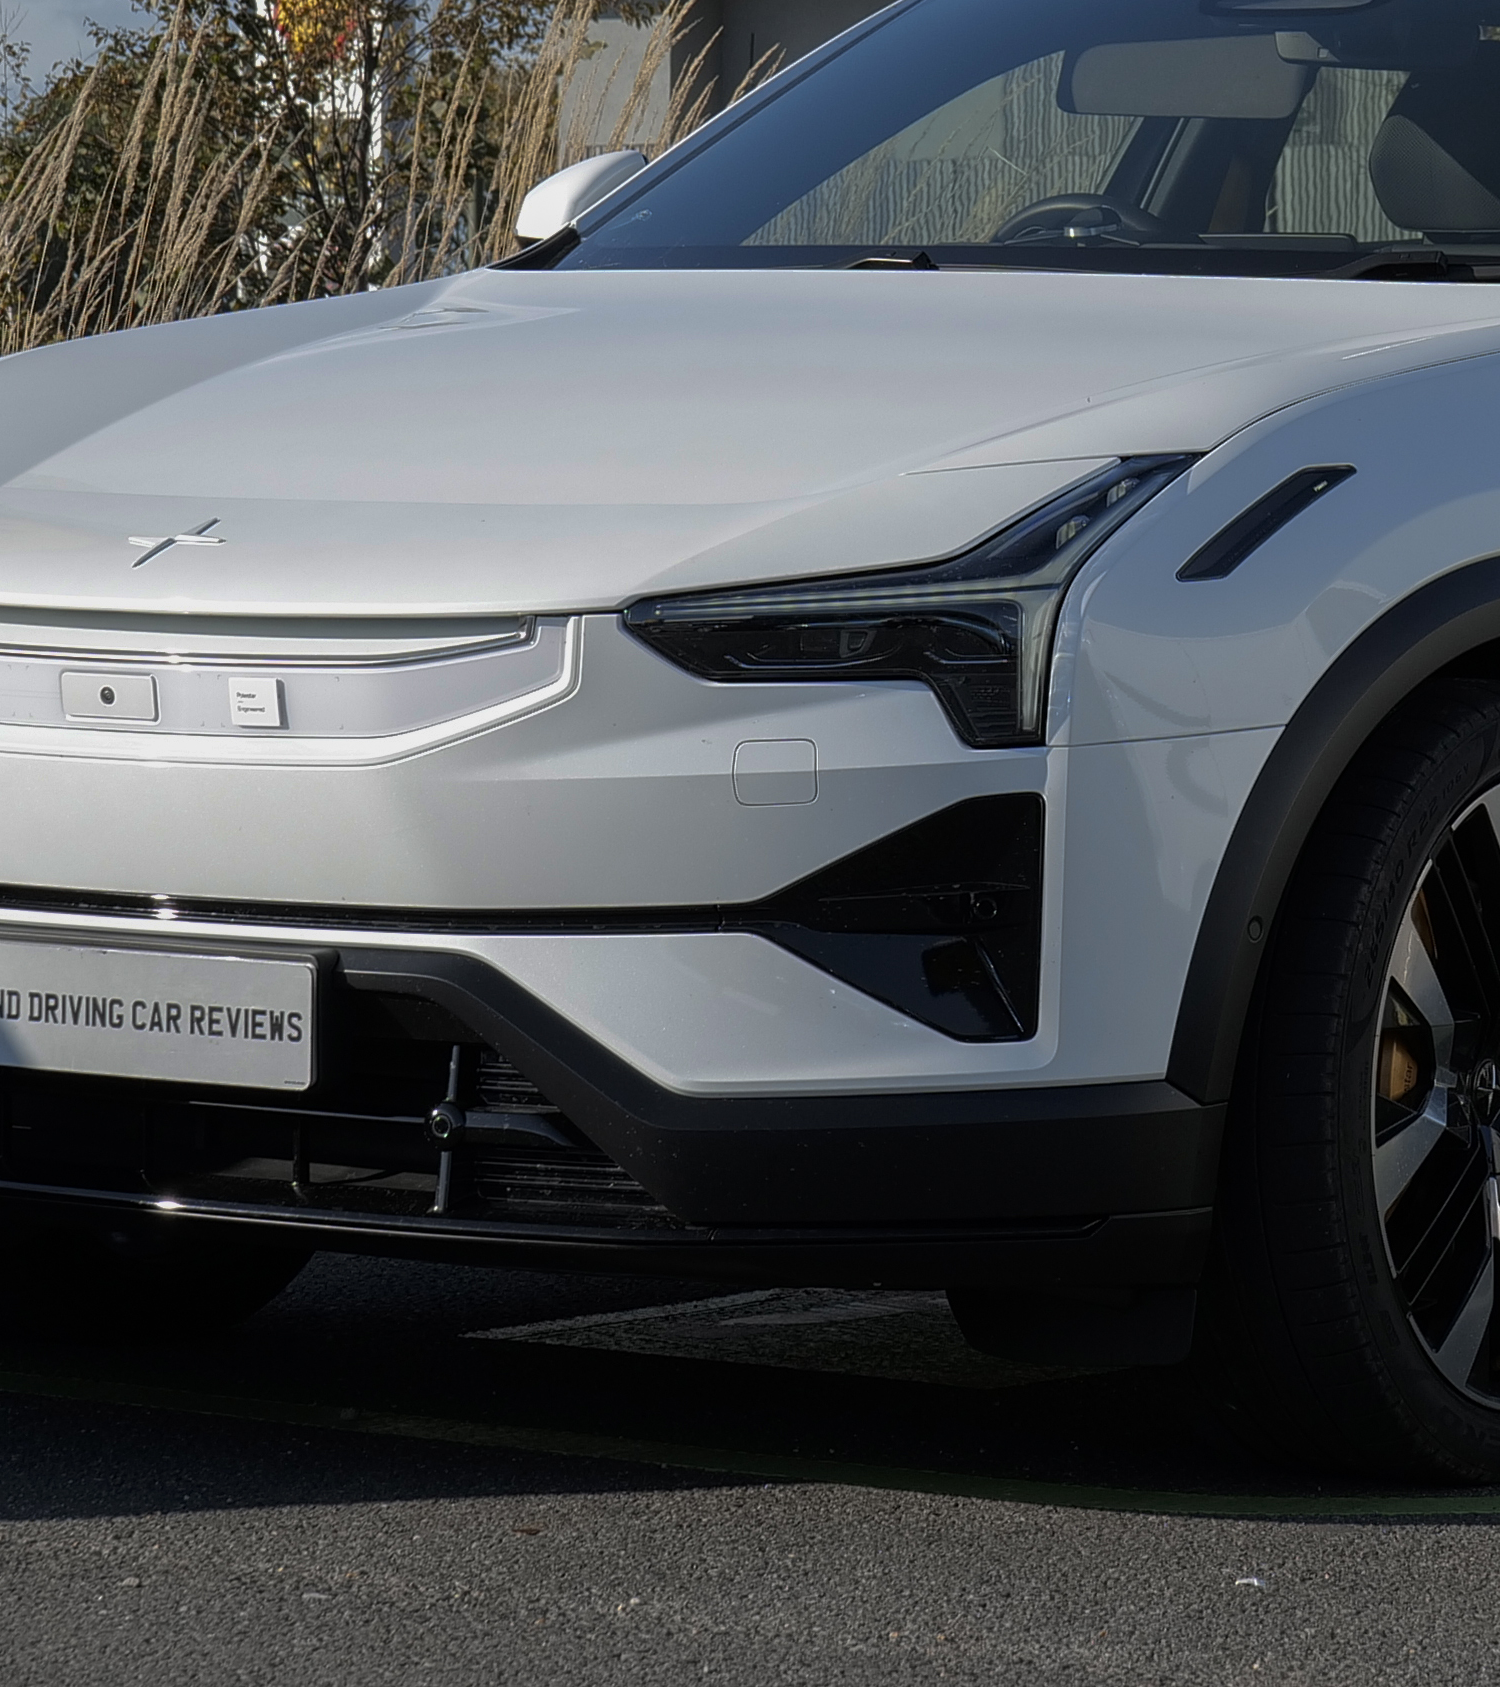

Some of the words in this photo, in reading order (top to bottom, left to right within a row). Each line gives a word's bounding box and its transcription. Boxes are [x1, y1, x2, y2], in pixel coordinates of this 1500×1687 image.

[28, 992, 124, 1030] DRIVING
[132, 1000, 181, 1034] CAR
[190, 1004, 303, 1043] REVIEWS
